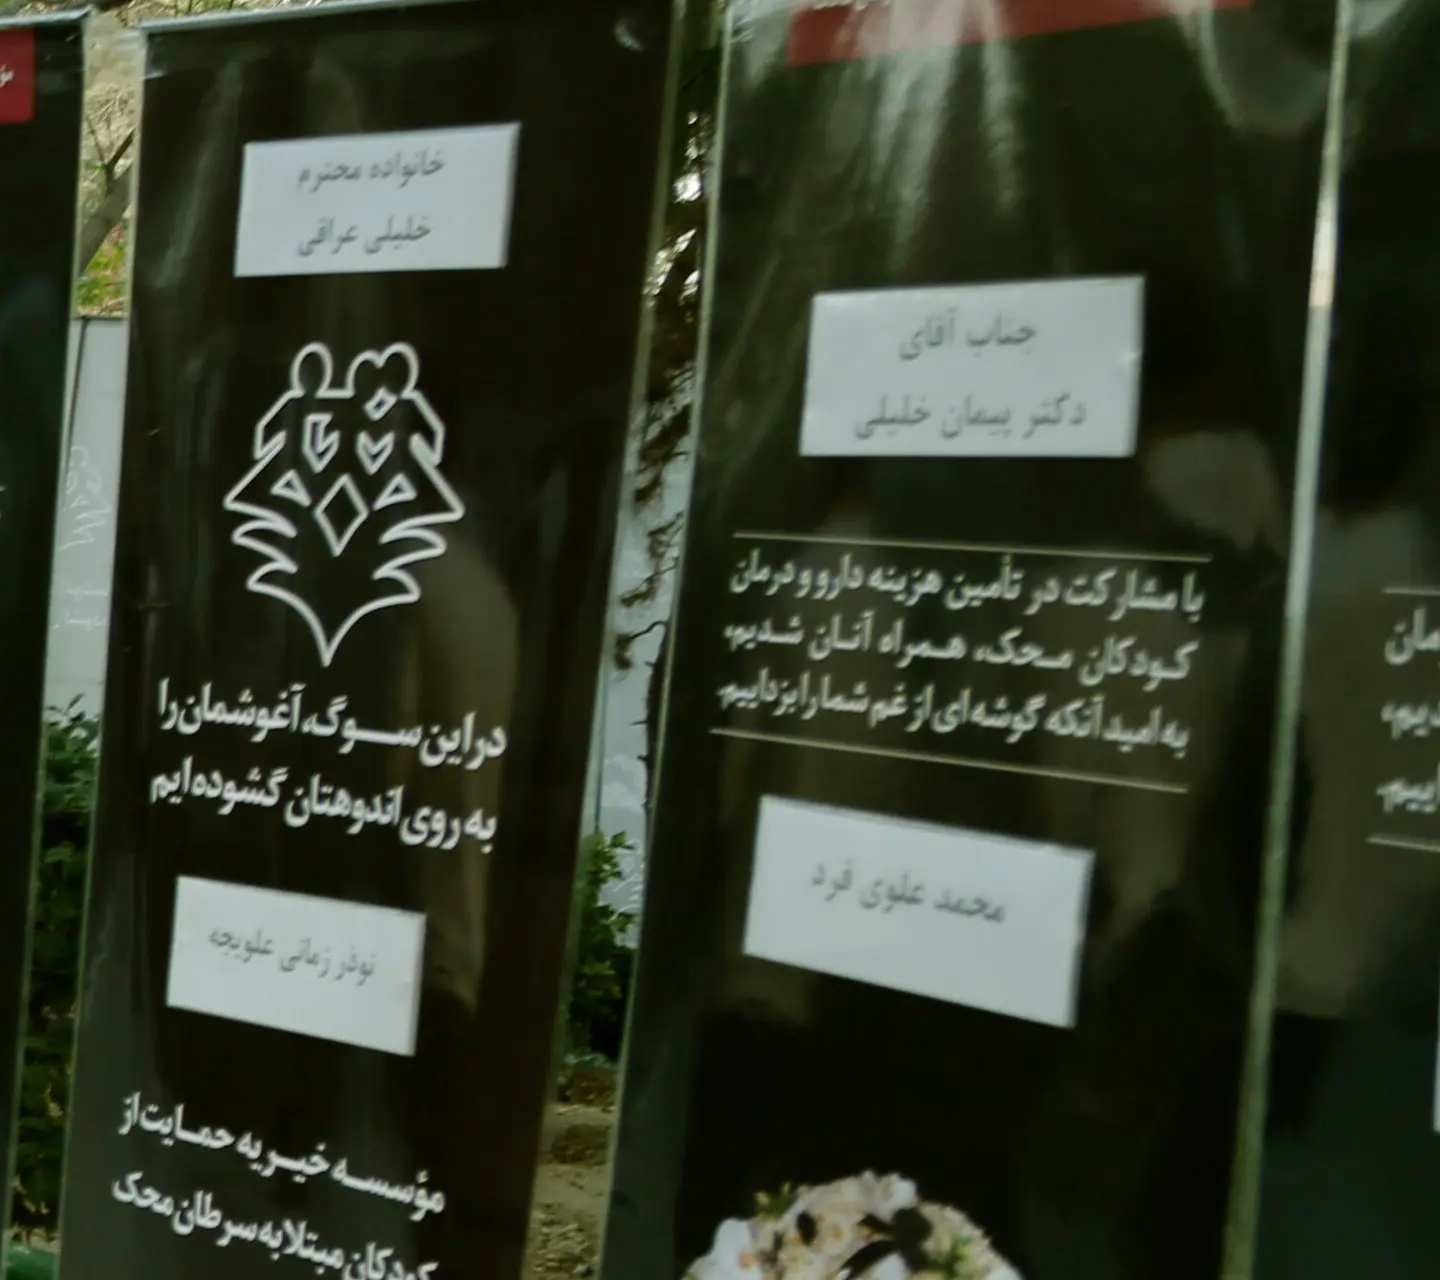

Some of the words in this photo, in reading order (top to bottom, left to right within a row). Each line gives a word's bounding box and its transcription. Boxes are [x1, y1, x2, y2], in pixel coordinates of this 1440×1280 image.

[297, 160, 361, 192] محترم
[369, 149, 445, 188] خانواده
[297, 217, 358, 256] عراقی
[364, 215, 430, 255] خلیلی
[898, 306, 958, 361] آقای
[965, 312, 1036, 358] جناب
[854, 395, 931, 440] خلیلی
[940, 395, 1011, 439] پیمان
[1023, 393, 1086, 439] دکتر
[732, 549, 795, 595] درمان
[796, 570, 811, 597] و
[813, 554, 864, 600] دارو
[867, 567, 941, 606] هزینه
[1064, 568, 1179, 621] مشارکت
[1024, 578, 1060, 615] در
[1182, 573, 1203, 622] با
[809, 609, 875, 660] آنان
[879, 619, 967, 668] همراه
[1079, 636, 1199, 691] کودکان
[159, 677, 179, 730] را
[178, 681, 306, 742] آغوشمان
[801, 671, 820, 718] را
[820, 675, 870, 712] شما
[869, 684, 907, 727] غم
[906, 684, 933, 732] از
[419, 711, 476, 766] این
[1044, 695, 1104, 740] آنکه
[1103, 706, 1162, 752] امید
[1160, 717, 1189, 758] به
[466, 726, 507, 769] در
[285, 773, 403, 834] اندوهتان
[399, 806, 460, 849] روی
[463, 809, 496, 854] به
[811, 856, 853, 902] فرد
[859, 872, 925, 914] علوی
[933, 889, 1006, 923] محمد
[209, 926, 274, 963] علویجه
[280, 937, 331, 978] زمانی
[334, 943, 377, 986] نوذر
[118, 1091, 140, 1134] از
[139, 1103, 234, 1148] حمایت
[236, 1131, 330, 1183] خیریه
[111, 1171, 174, 1215] محک
[332, 1157, 445, 1222] مؤسسه
[171, 1190, 257, 1246] سرطان
[257, 1221, 283, 1261] به
[282, 1219, 344, 1276] مبتلا
